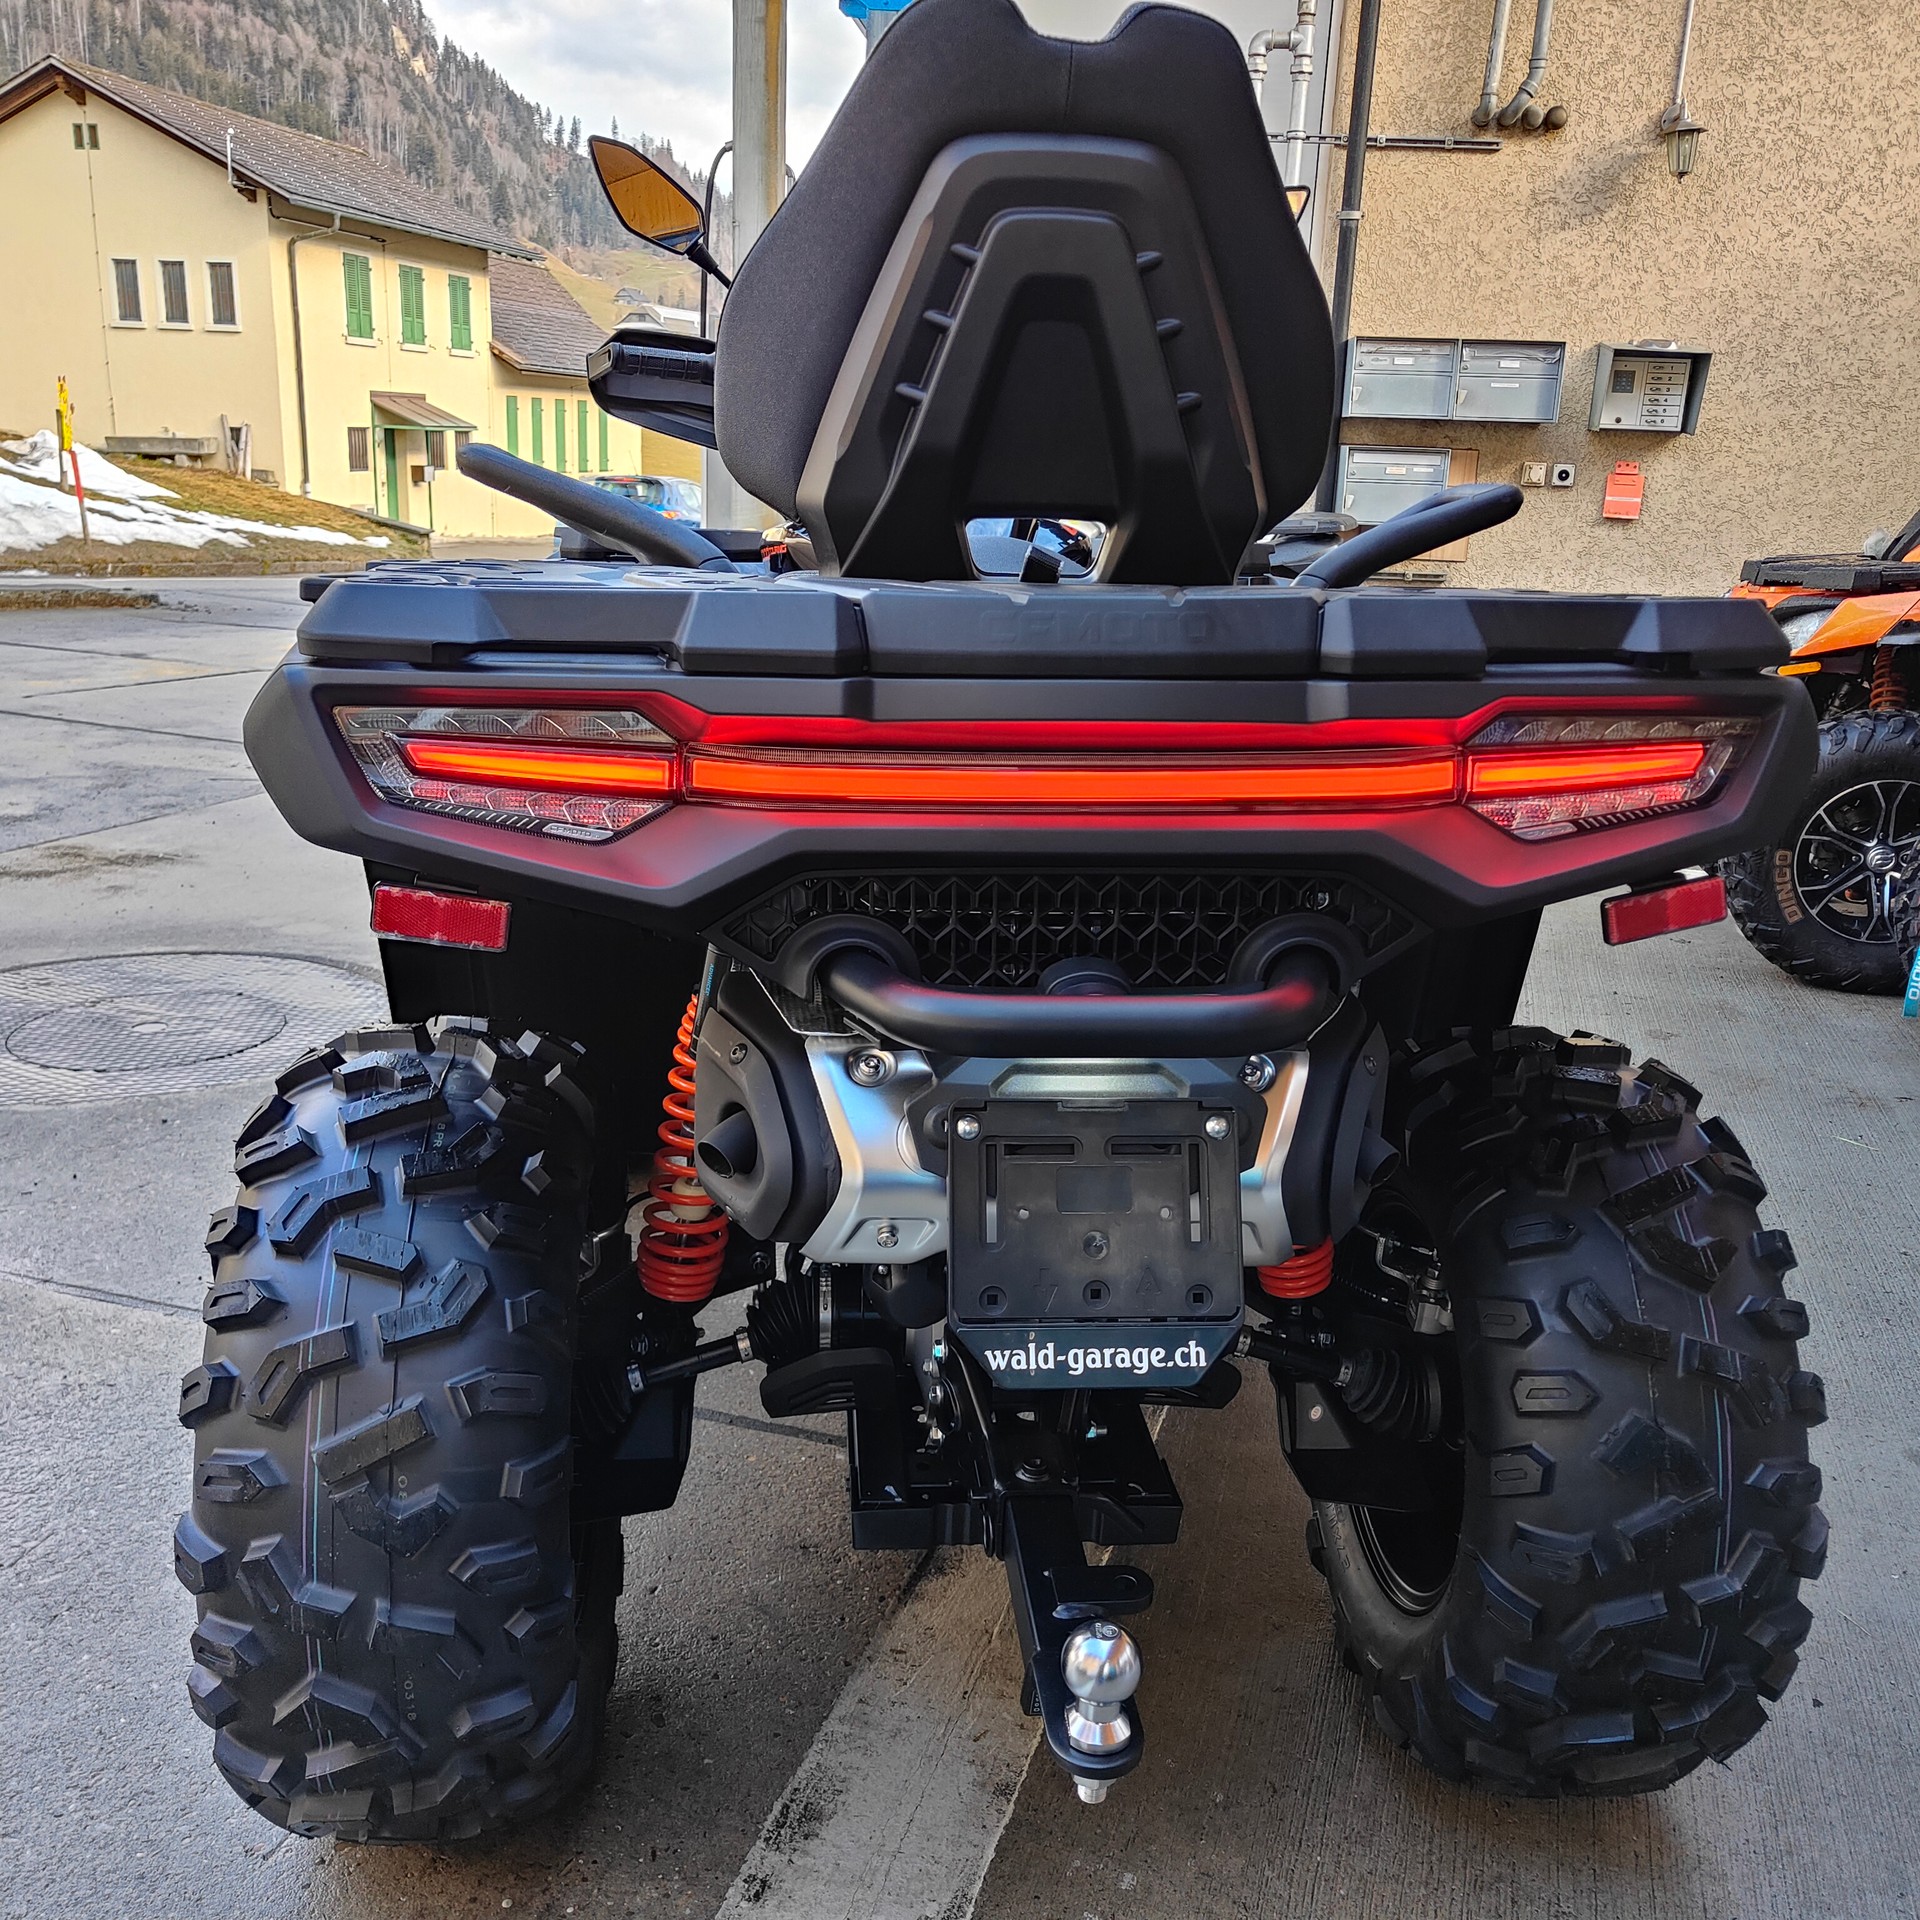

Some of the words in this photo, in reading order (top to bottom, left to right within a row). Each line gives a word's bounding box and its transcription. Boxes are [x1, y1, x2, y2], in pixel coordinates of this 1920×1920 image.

[979, 609, 1215, 644] CFMOTO
[1774, 849, 1804, 925] DINGO
[984, 1340, 1207, 1375] wald-garage.ch
